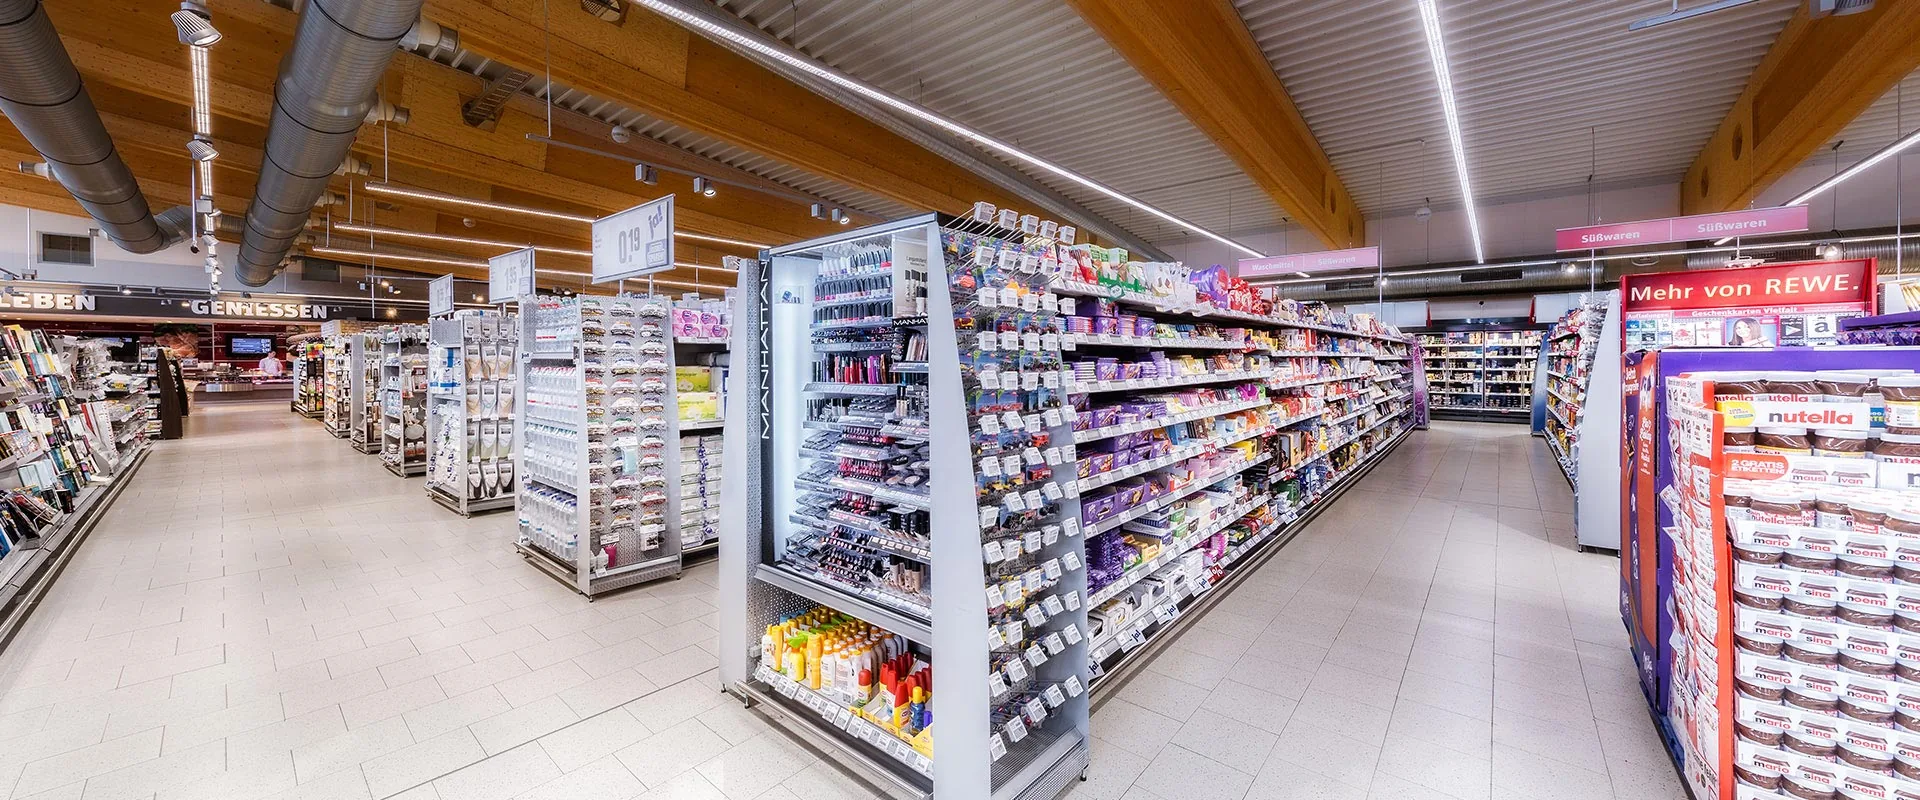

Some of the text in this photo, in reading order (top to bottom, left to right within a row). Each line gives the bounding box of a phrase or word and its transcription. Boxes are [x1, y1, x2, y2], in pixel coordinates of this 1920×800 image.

[648, 205, 664, 240] ja!
[1581, 217, 1767, 244] Süßwaren Süßwaren
[1252, 261, 1294, 271] Waschmittel
[1631, 273, 1860, 302] Mehr von REWE.
[191, 300, 327, 319] GENIESSEN
[1692, 308, 1761, 317] Geschenkkarten
[1763, 306, 1798, 314] Vielfalt
[893, 316, 928, 326] MANHAT
[760, 261, 770, 440] MANHATTAN
[1769, 394, 1809, 402] utella
[1769, 411, 1853, 425] nutella
[1741, 460, 1785, 470] GRATIS
[1792, 475, 1827, 483] mausi
[1753, 537, 1790, 547] mario
[1804, 543, 1831, 552] sina
[1846, 548, 1887, 558] noemi
[1754, 582, 1790, 592] mario
[1805, 589, 1831, 598] sina
[1846, 595, 1886, 607] noemi
[1166, 605, 1176, 617] ja!
[1131, 629, 1141, 643] ja!
[1755, 627, 1792, 638] mario
[1806, 635, 1832, 646] sina
[1847, 642, 1888, 655] noemi
[1088, 660, 1100, 676] ja!
[1755, 672, 1791, 684] mario
[1805, 682, 1832, 692] sina
[1847, 690, 1887, 704] noemi
[1755, 716, 1791, 730] mario
[1805, 728, 1831, 739] sina
[1846, 737, 1887, 751] noemi
[1754, 760, 1790, 774] mario
[1804, 773, 1830, 784] sina
[1845, 783, 1886, 798] noemi
